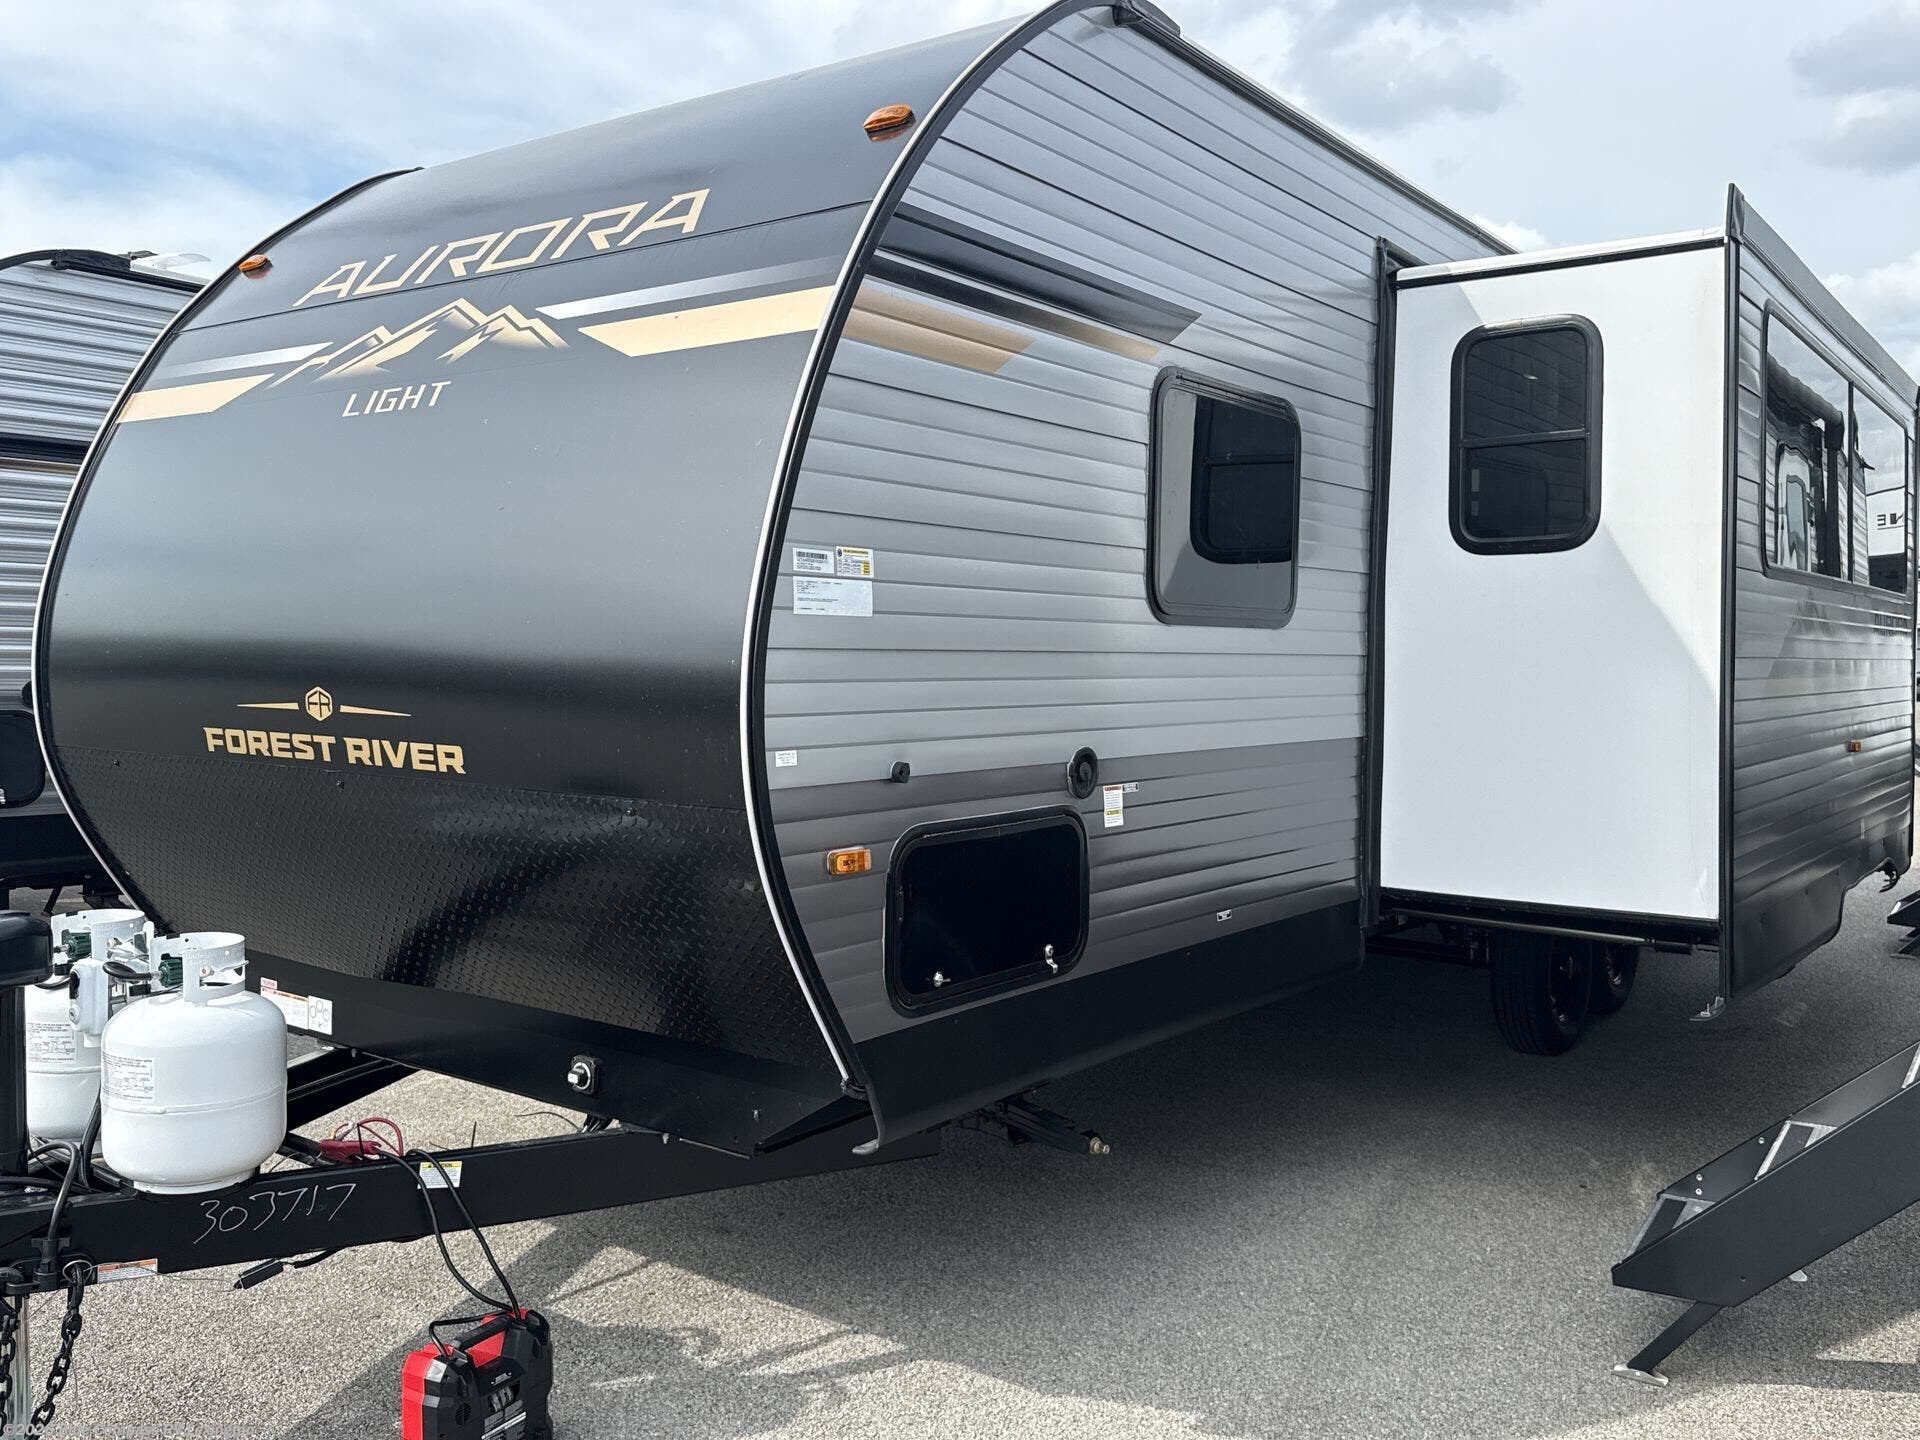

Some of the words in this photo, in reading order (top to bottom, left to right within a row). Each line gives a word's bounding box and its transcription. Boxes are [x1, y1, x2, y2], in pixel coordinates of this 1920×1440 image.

[293, 188, 712, 308] AURORA
[342, 379, 452, 419] LIGHT
[203, 726, 337, 763] FOREST
[343, 736, 467, 775] RIVER
